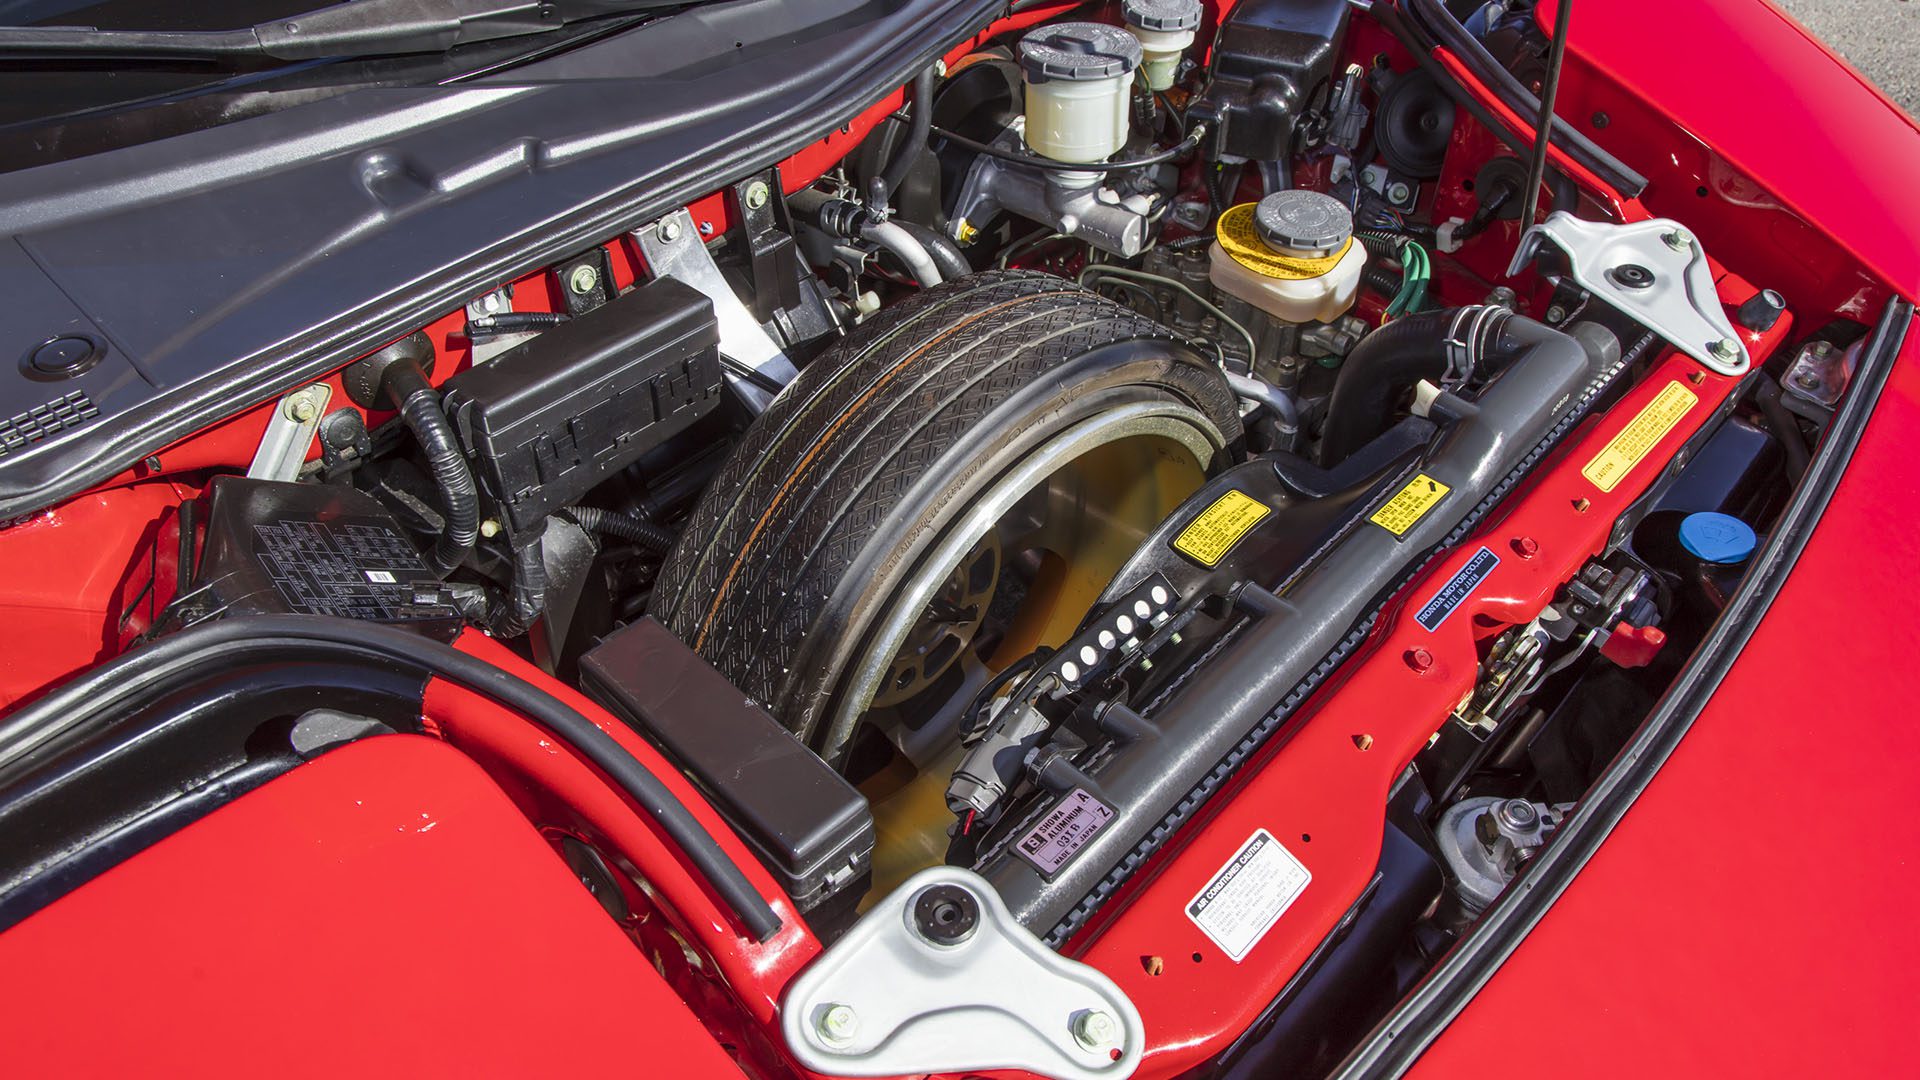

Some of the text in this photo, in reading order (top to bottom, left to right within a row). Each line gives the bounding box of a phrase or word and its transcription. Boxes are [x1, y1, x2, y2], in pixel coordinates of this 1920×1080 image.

[1182, 523, 1202, 541] DANGER
[1419, 597, 1445, 622] HONDA
[1443, 573, 1468, 598] MOTOR
[1443, 574, 1479, 610] MADE IN JAPAN
[1077, 792, 1089, 803] A
[1097, 806, 1110, 818] Z
[1039, 810, 1065, 833] SHOWA
[1047, 806, 1084, 839] ALUMINUM
[1054, 851, 1071, 865] MADE
[1080, 824, 1098, 841] JAPAN
[1196, 839, 1264, 911] AIR CONDITIONER CAUTION
